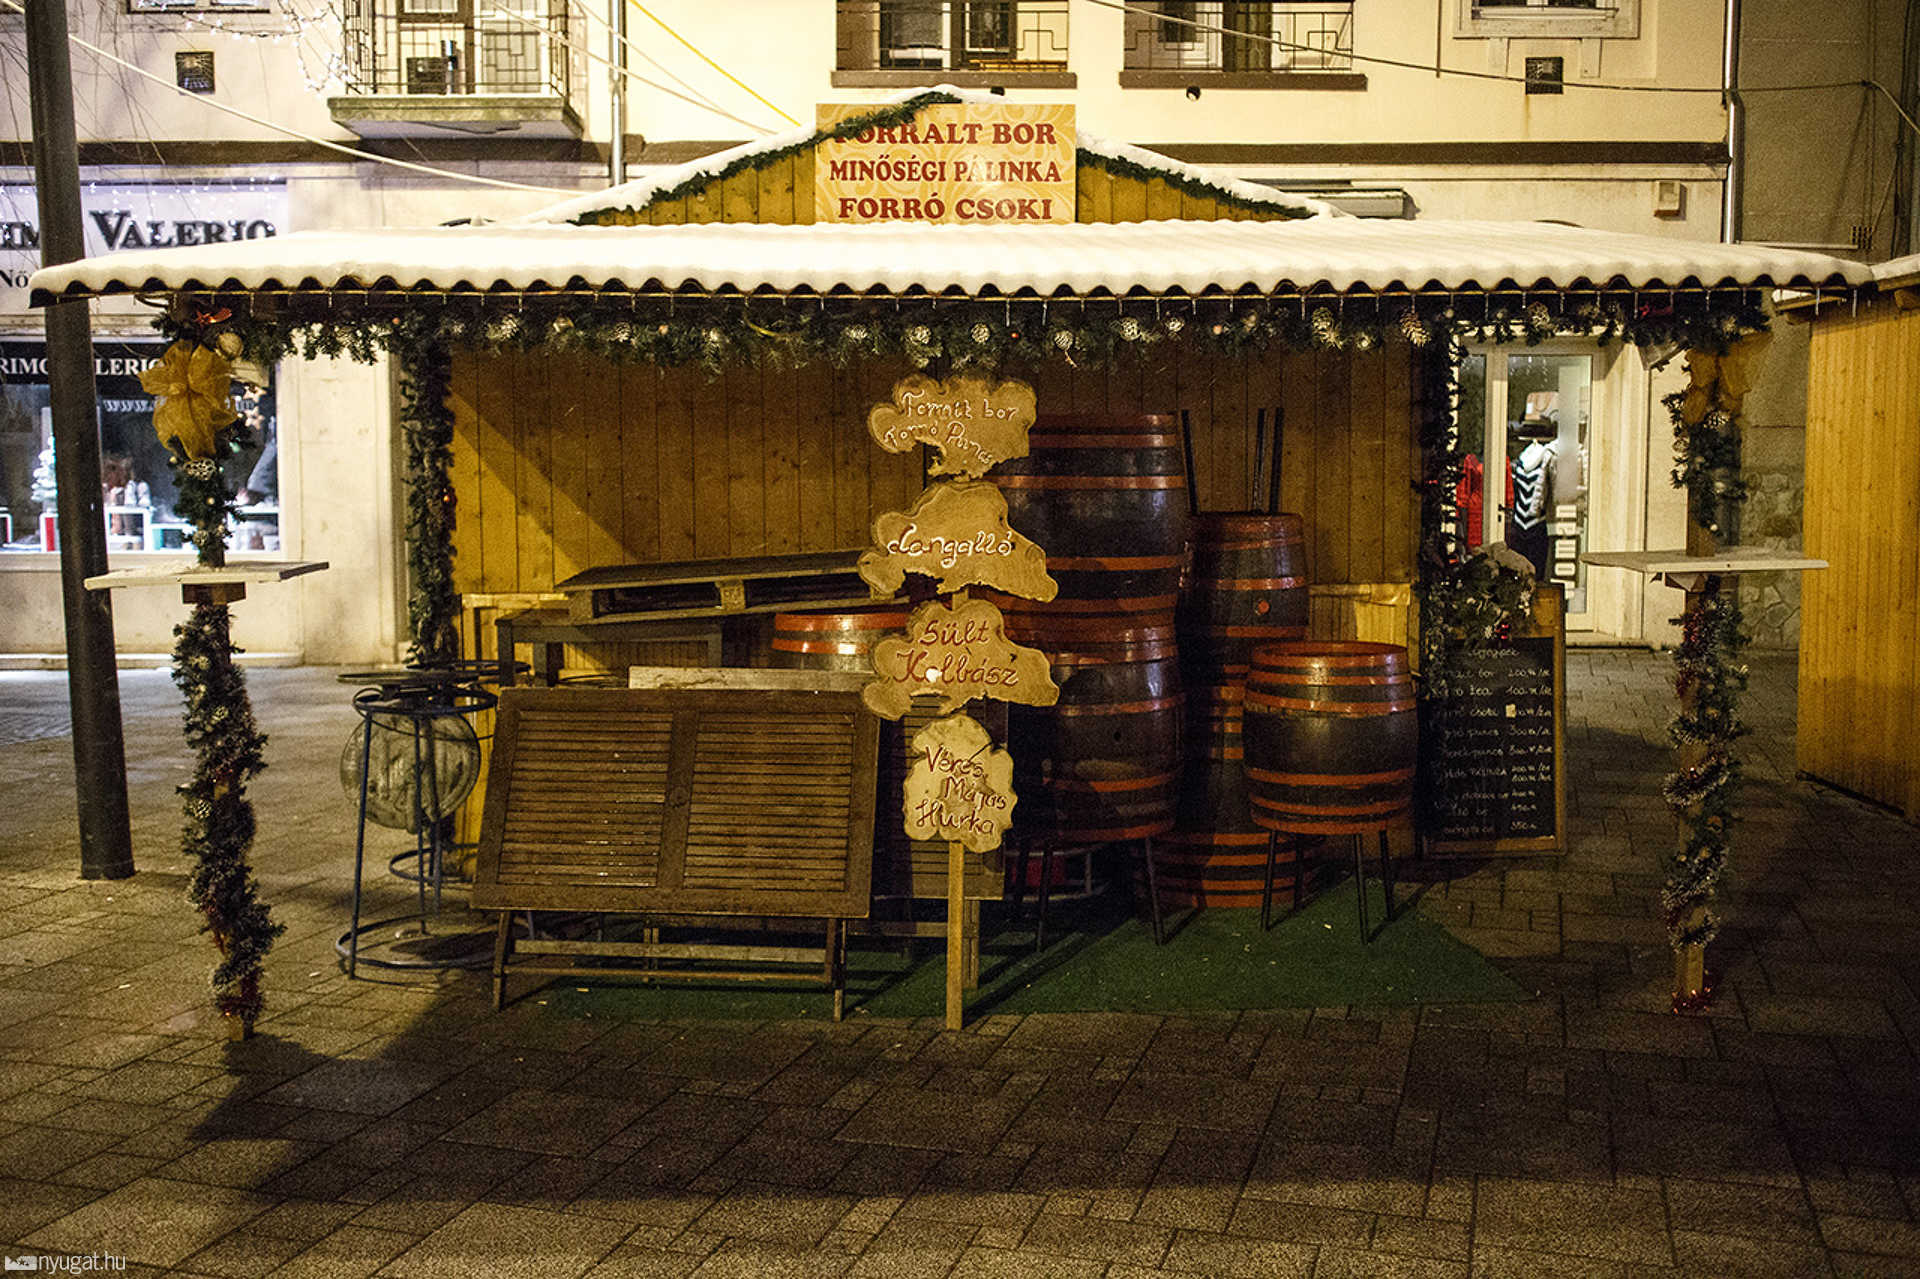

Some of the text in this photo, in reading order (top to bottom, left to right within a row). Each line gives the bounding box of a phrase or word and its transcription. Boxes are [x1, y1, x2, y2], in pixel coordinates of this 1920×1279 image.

[834, 122, 1056, 144] ORRALT BOR
[829, 154, 1061, 182] MINŐSÉGI PÁLINKA
[838, 192, 1052, 220] FORRÓ CSOKI
[983, 398, 1019, 421] bor
[918, 618, 991, 646] Sült
[914, 799, 995, 834] Hurka
